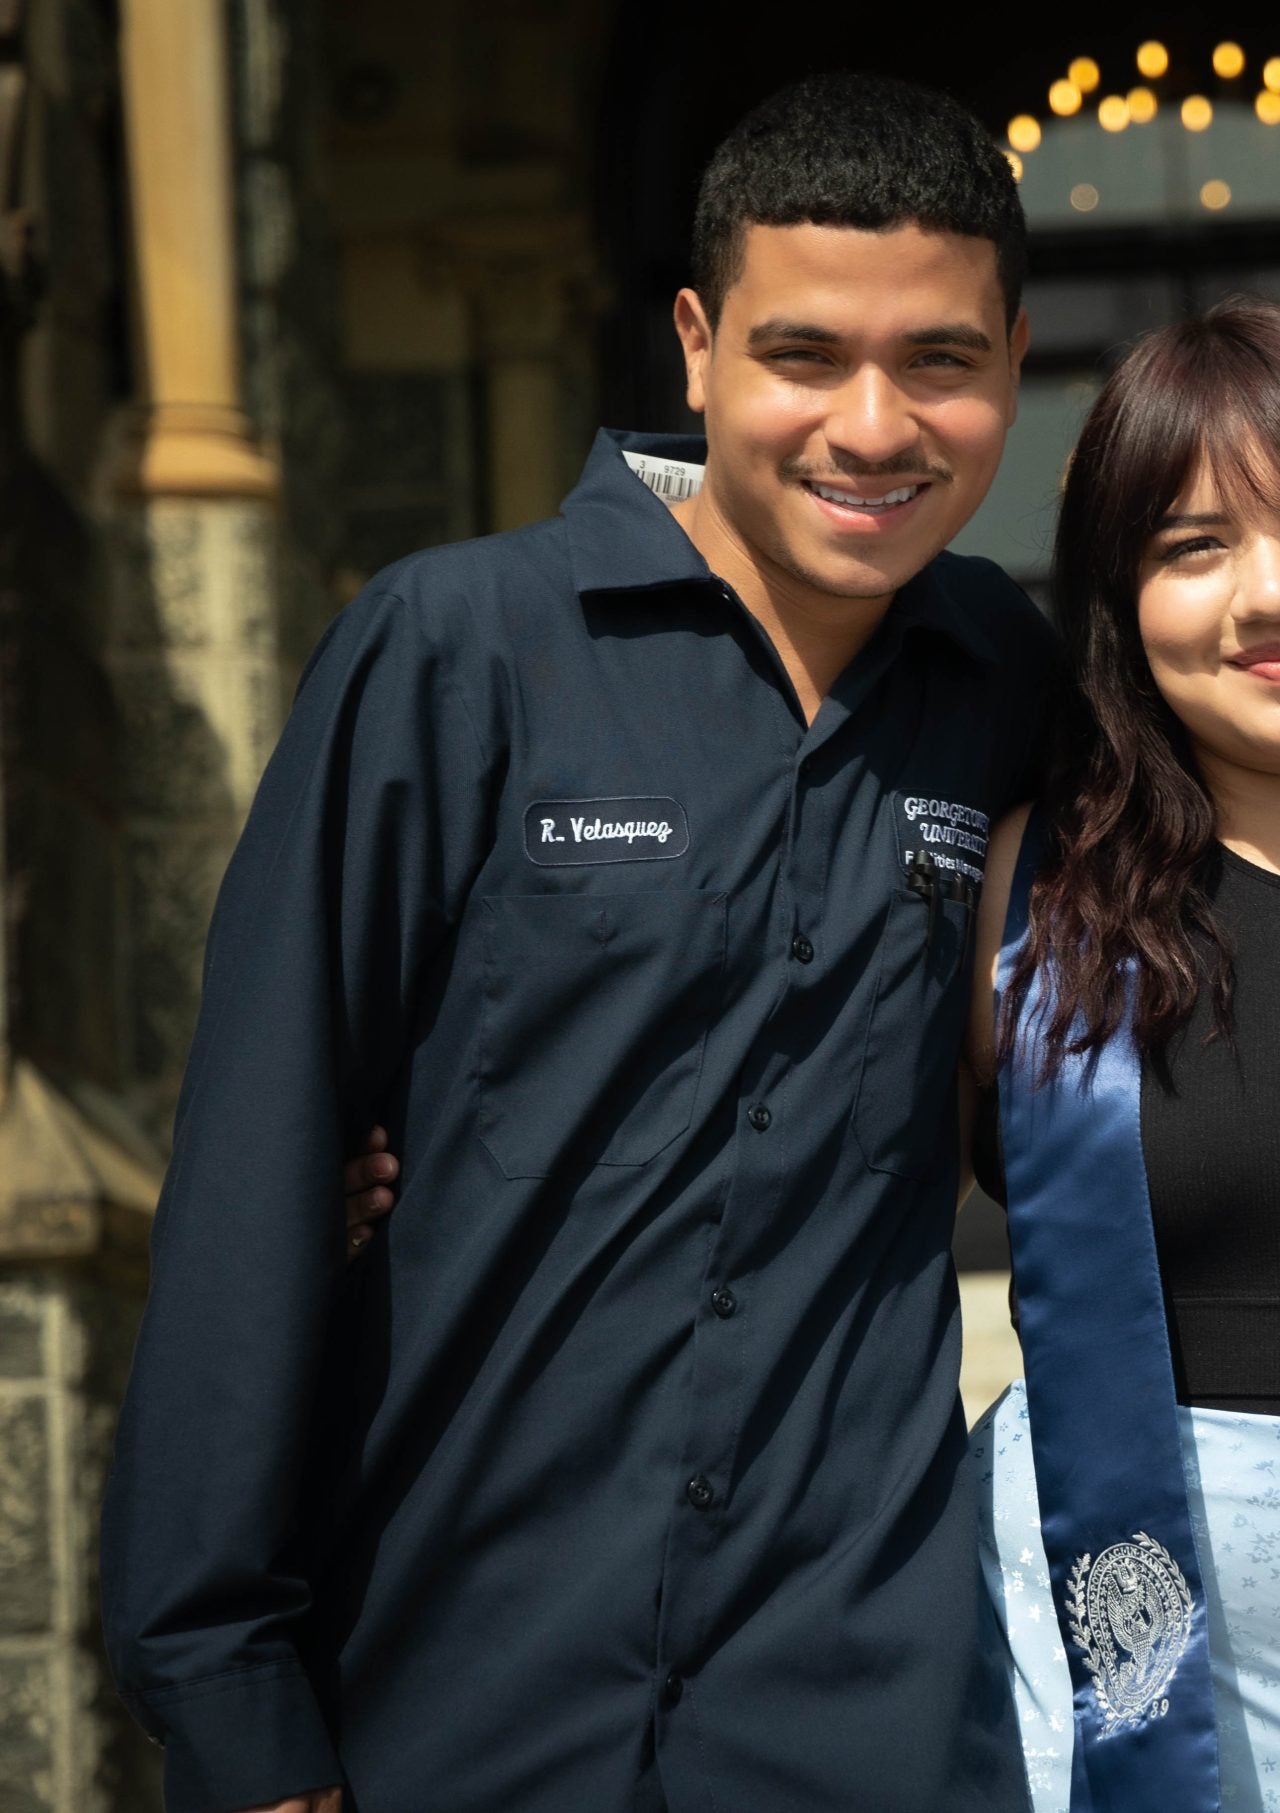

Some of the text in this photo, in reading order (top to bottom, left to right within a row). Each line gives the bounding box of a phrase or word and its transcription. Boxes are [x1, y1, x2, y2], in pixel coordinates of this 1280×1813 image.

[640, 460, 686, 476] 3 9729
[570, 817, 673, 844] Velasquez
